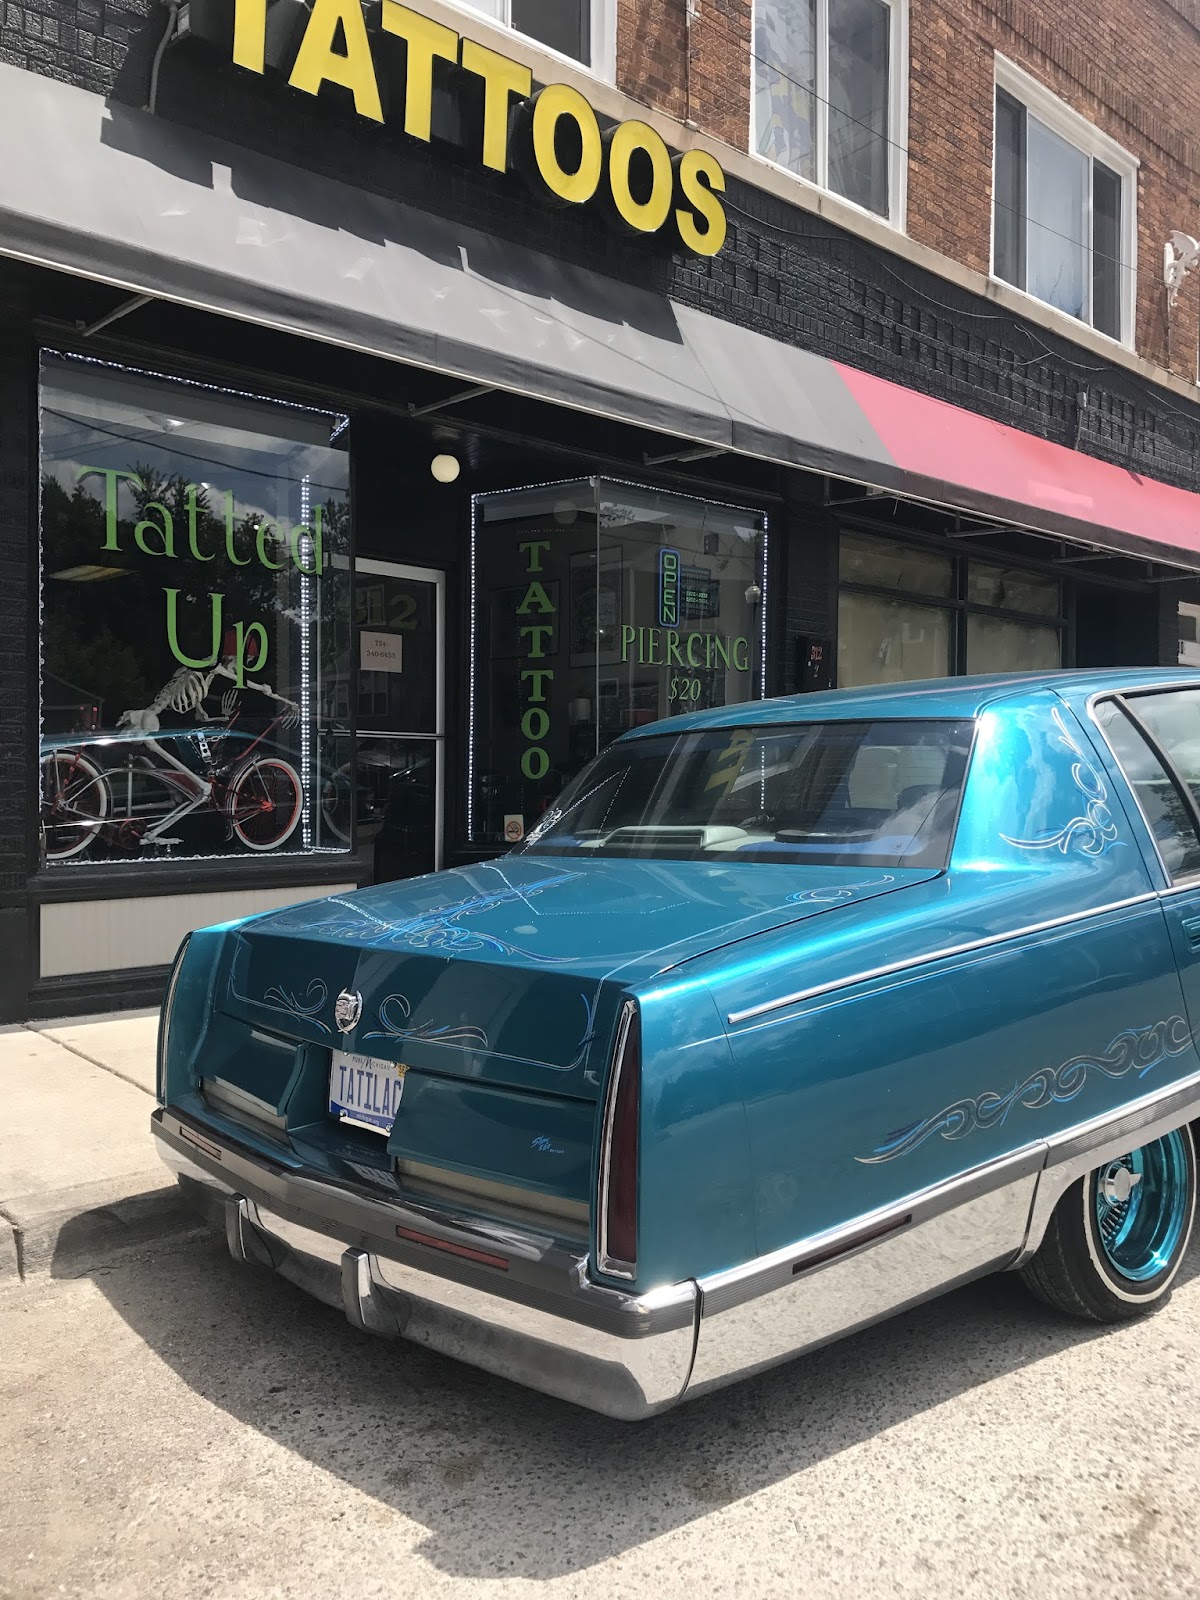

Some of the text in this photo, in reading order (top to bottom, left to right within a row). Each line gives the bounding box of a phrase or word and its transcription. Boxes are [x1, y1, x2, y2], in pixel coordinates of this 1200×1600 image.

[73, 464, 324, 576] Tatted
[663, 554, 677, 623] OPEN
[162, 587, 269, 690] Up
[516, 540, 557, 780] TATTOO
[620, 624, 750, 672] PIERCING
[668, 675, 702, 704] $20
[339, 1064, 402, 1118] TATILAC
